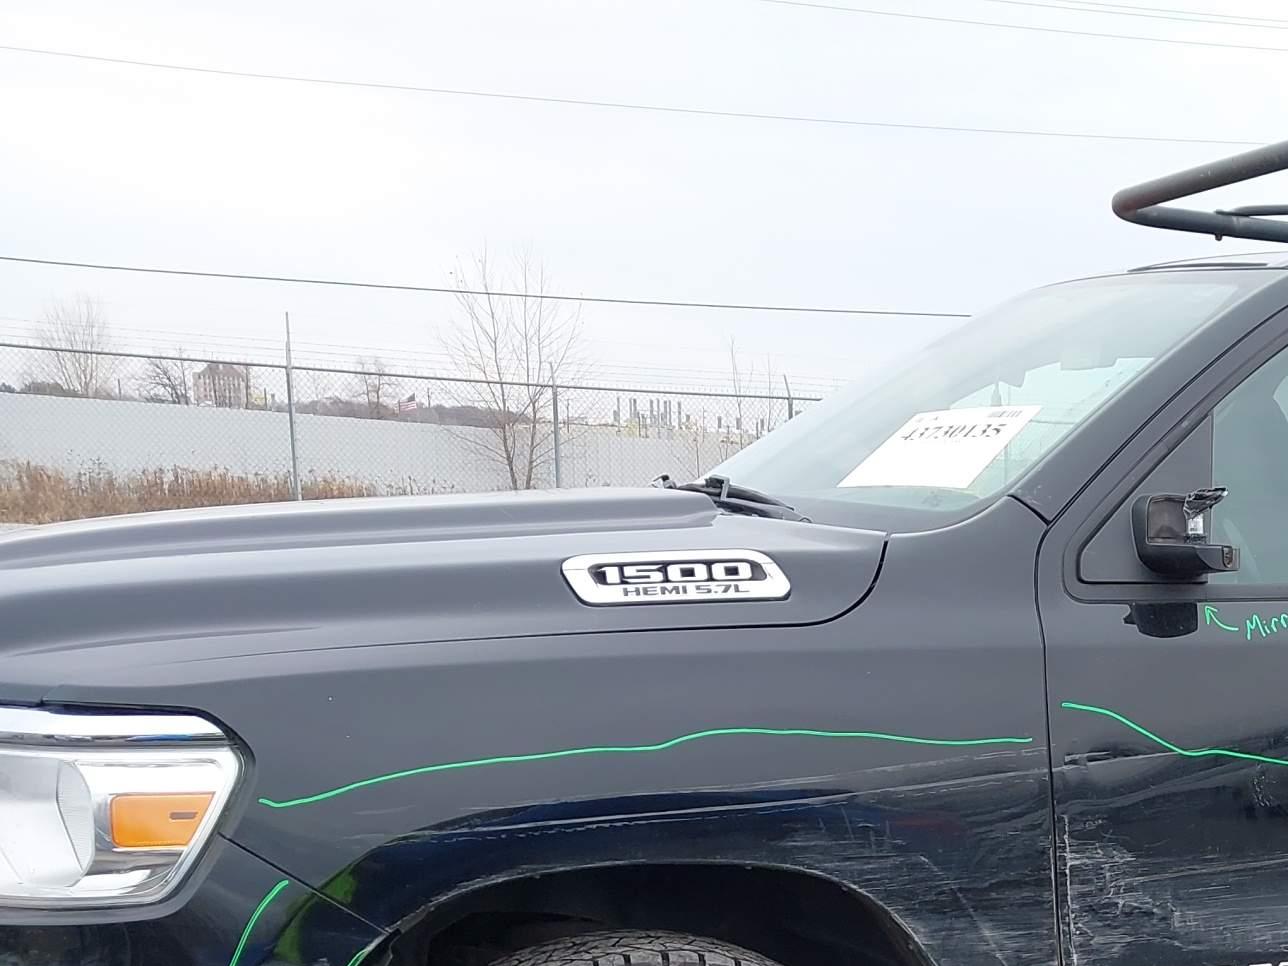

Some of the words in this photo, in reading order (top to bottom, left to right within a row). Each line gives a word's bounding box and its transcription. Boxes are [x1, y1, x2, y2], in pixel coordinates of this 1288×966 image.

[597, 561, 753, 584] 1500
[623, 585, 688, 597] HEMI
[696, 584, 750, 595] 5.7L
